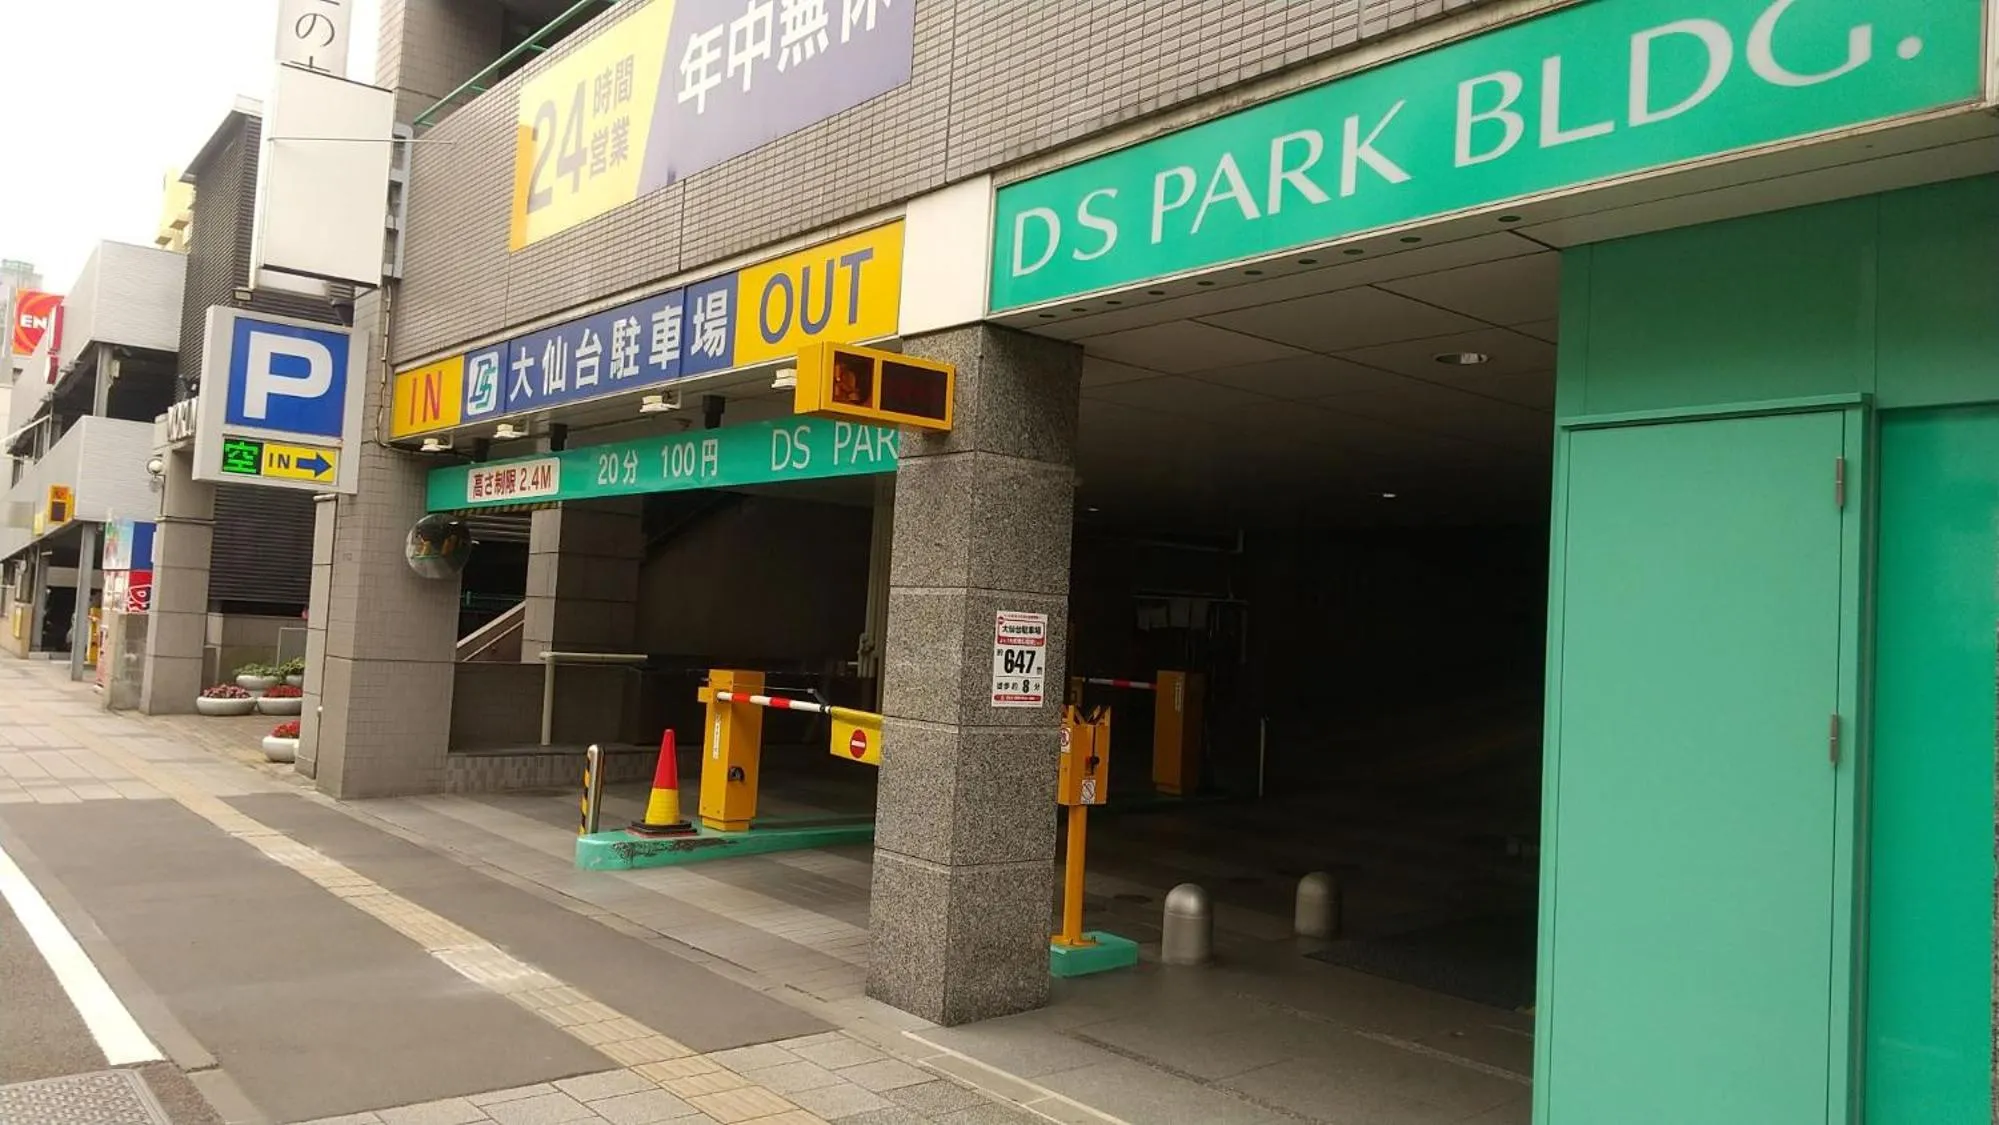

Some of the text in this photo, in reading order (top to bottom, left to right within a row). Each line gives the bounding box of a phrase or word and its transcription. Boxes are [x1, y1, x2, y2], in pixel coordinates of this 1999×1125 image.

[592, 55, 635, 119] 時間
[526, 78, 587, 214] 24
[589, 121, 631, 179] 営業
[1012, 0, 1923, 278] DS PARK BLDG.
[758, 247, 874, 345] OUT
[510, 289, 728, 402] 大仙台駐車場
[243, 330, 333, 420] P
[410, 370, 443, 426] IN
[223, 441, 260, 474] 空
[268, 452, 291, 470] IN
[661, 438, 719, 478] 100円
[771, 420, 901, 472] DS PAR
[473, 465, 552, 499] 高さ制限 2.4M
[1004, 648, 1036, 674] 647
